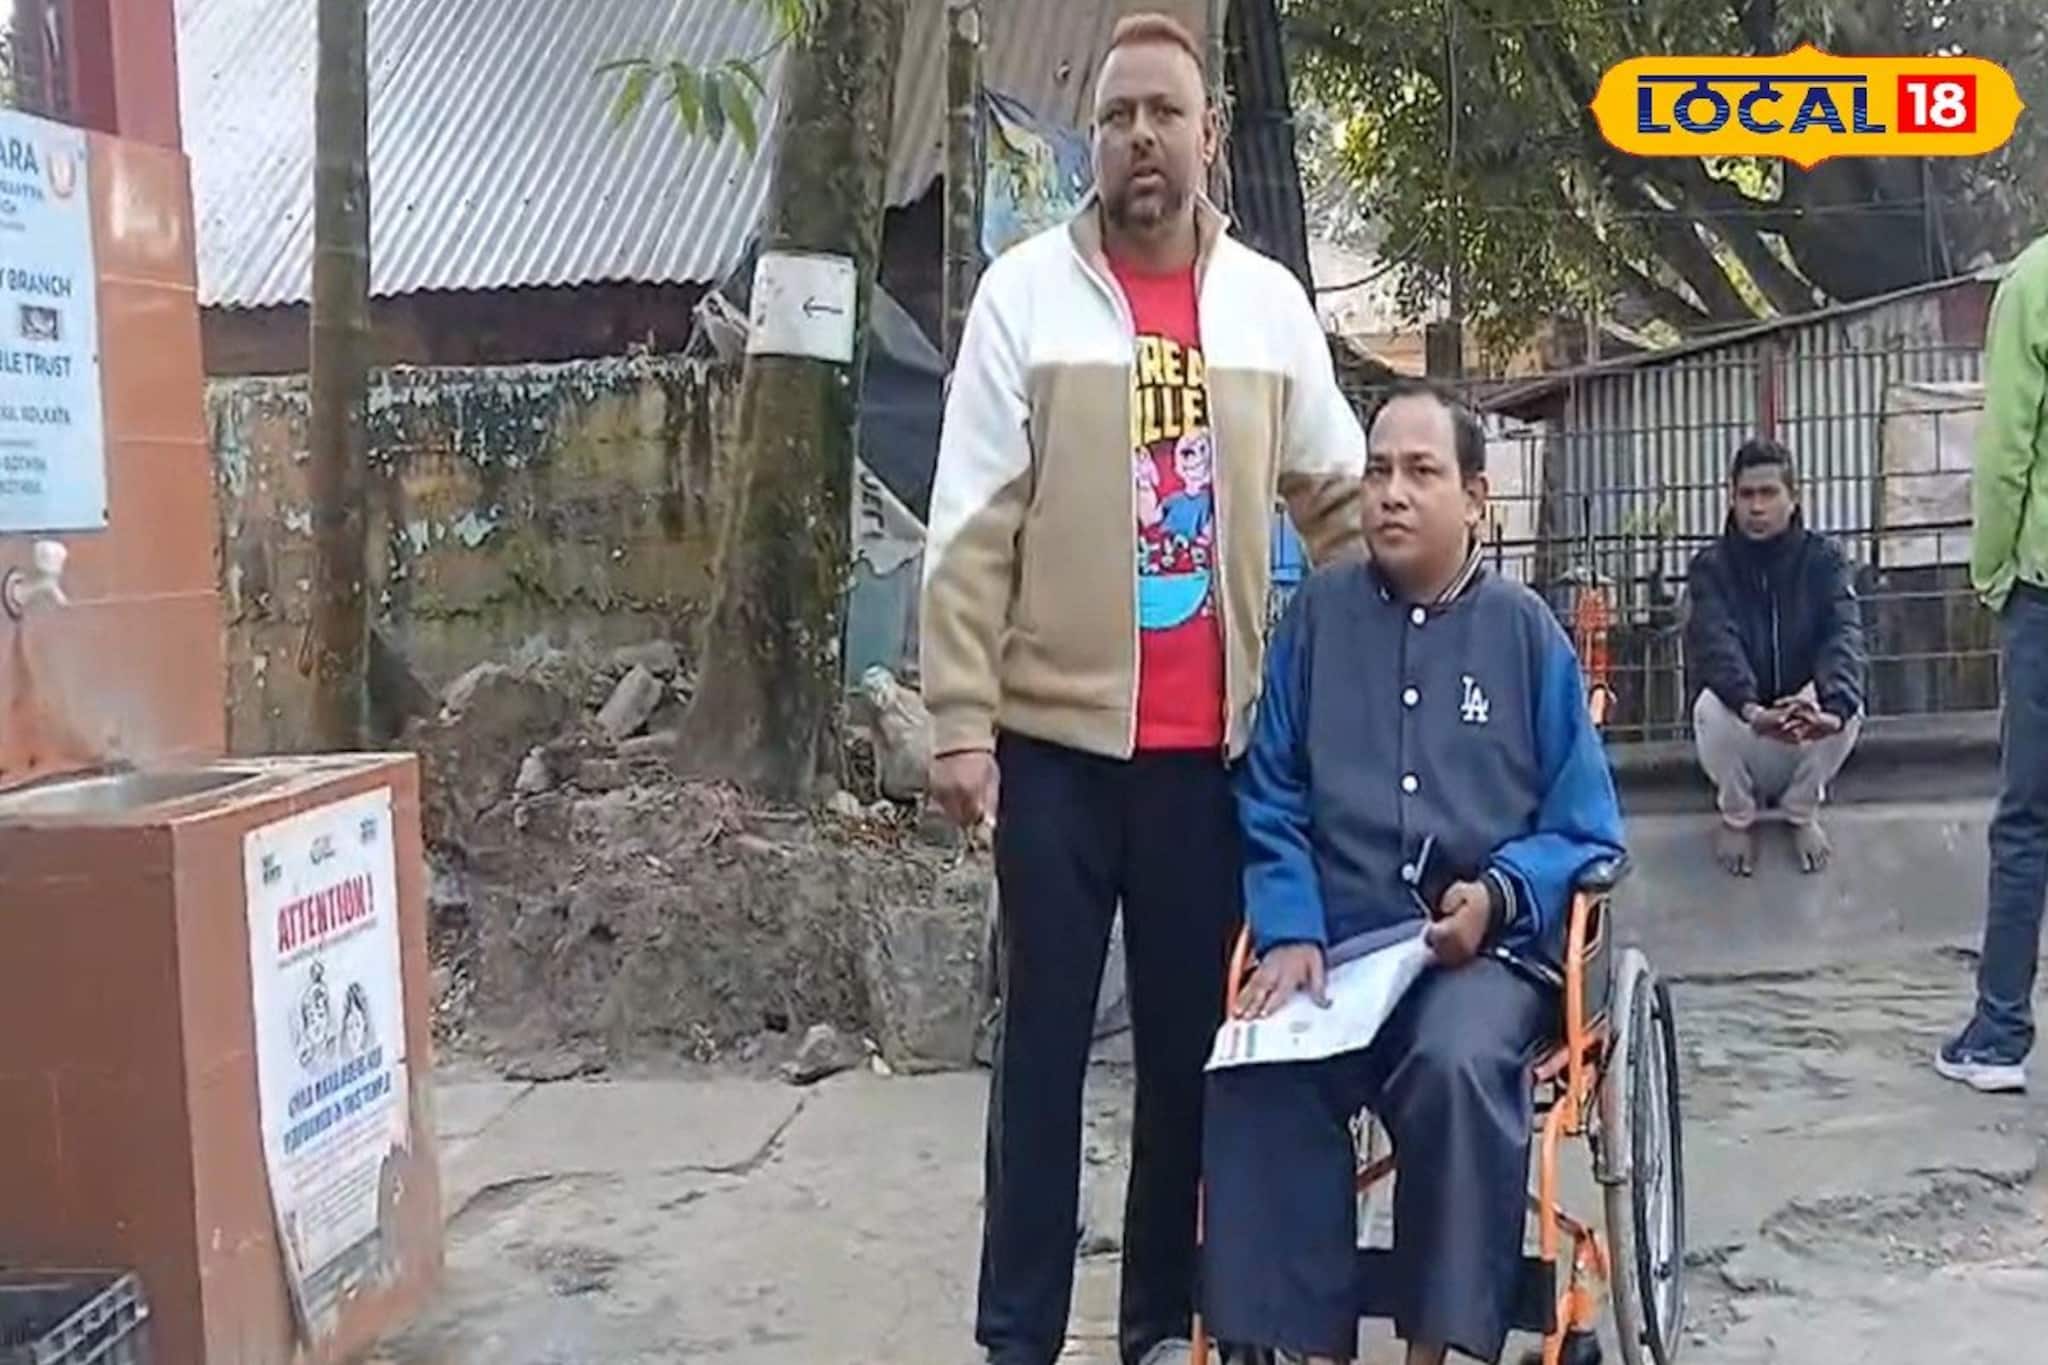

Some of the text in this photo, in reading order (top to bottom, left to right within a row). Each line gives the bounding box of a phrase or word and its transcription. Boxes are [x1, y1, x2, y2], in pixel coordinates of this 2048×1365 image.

[8, 267, 71, 298] BRANCH
[0, 347, 71, 377] LE TRUST
[1460, 674, 1489, 722] LA
